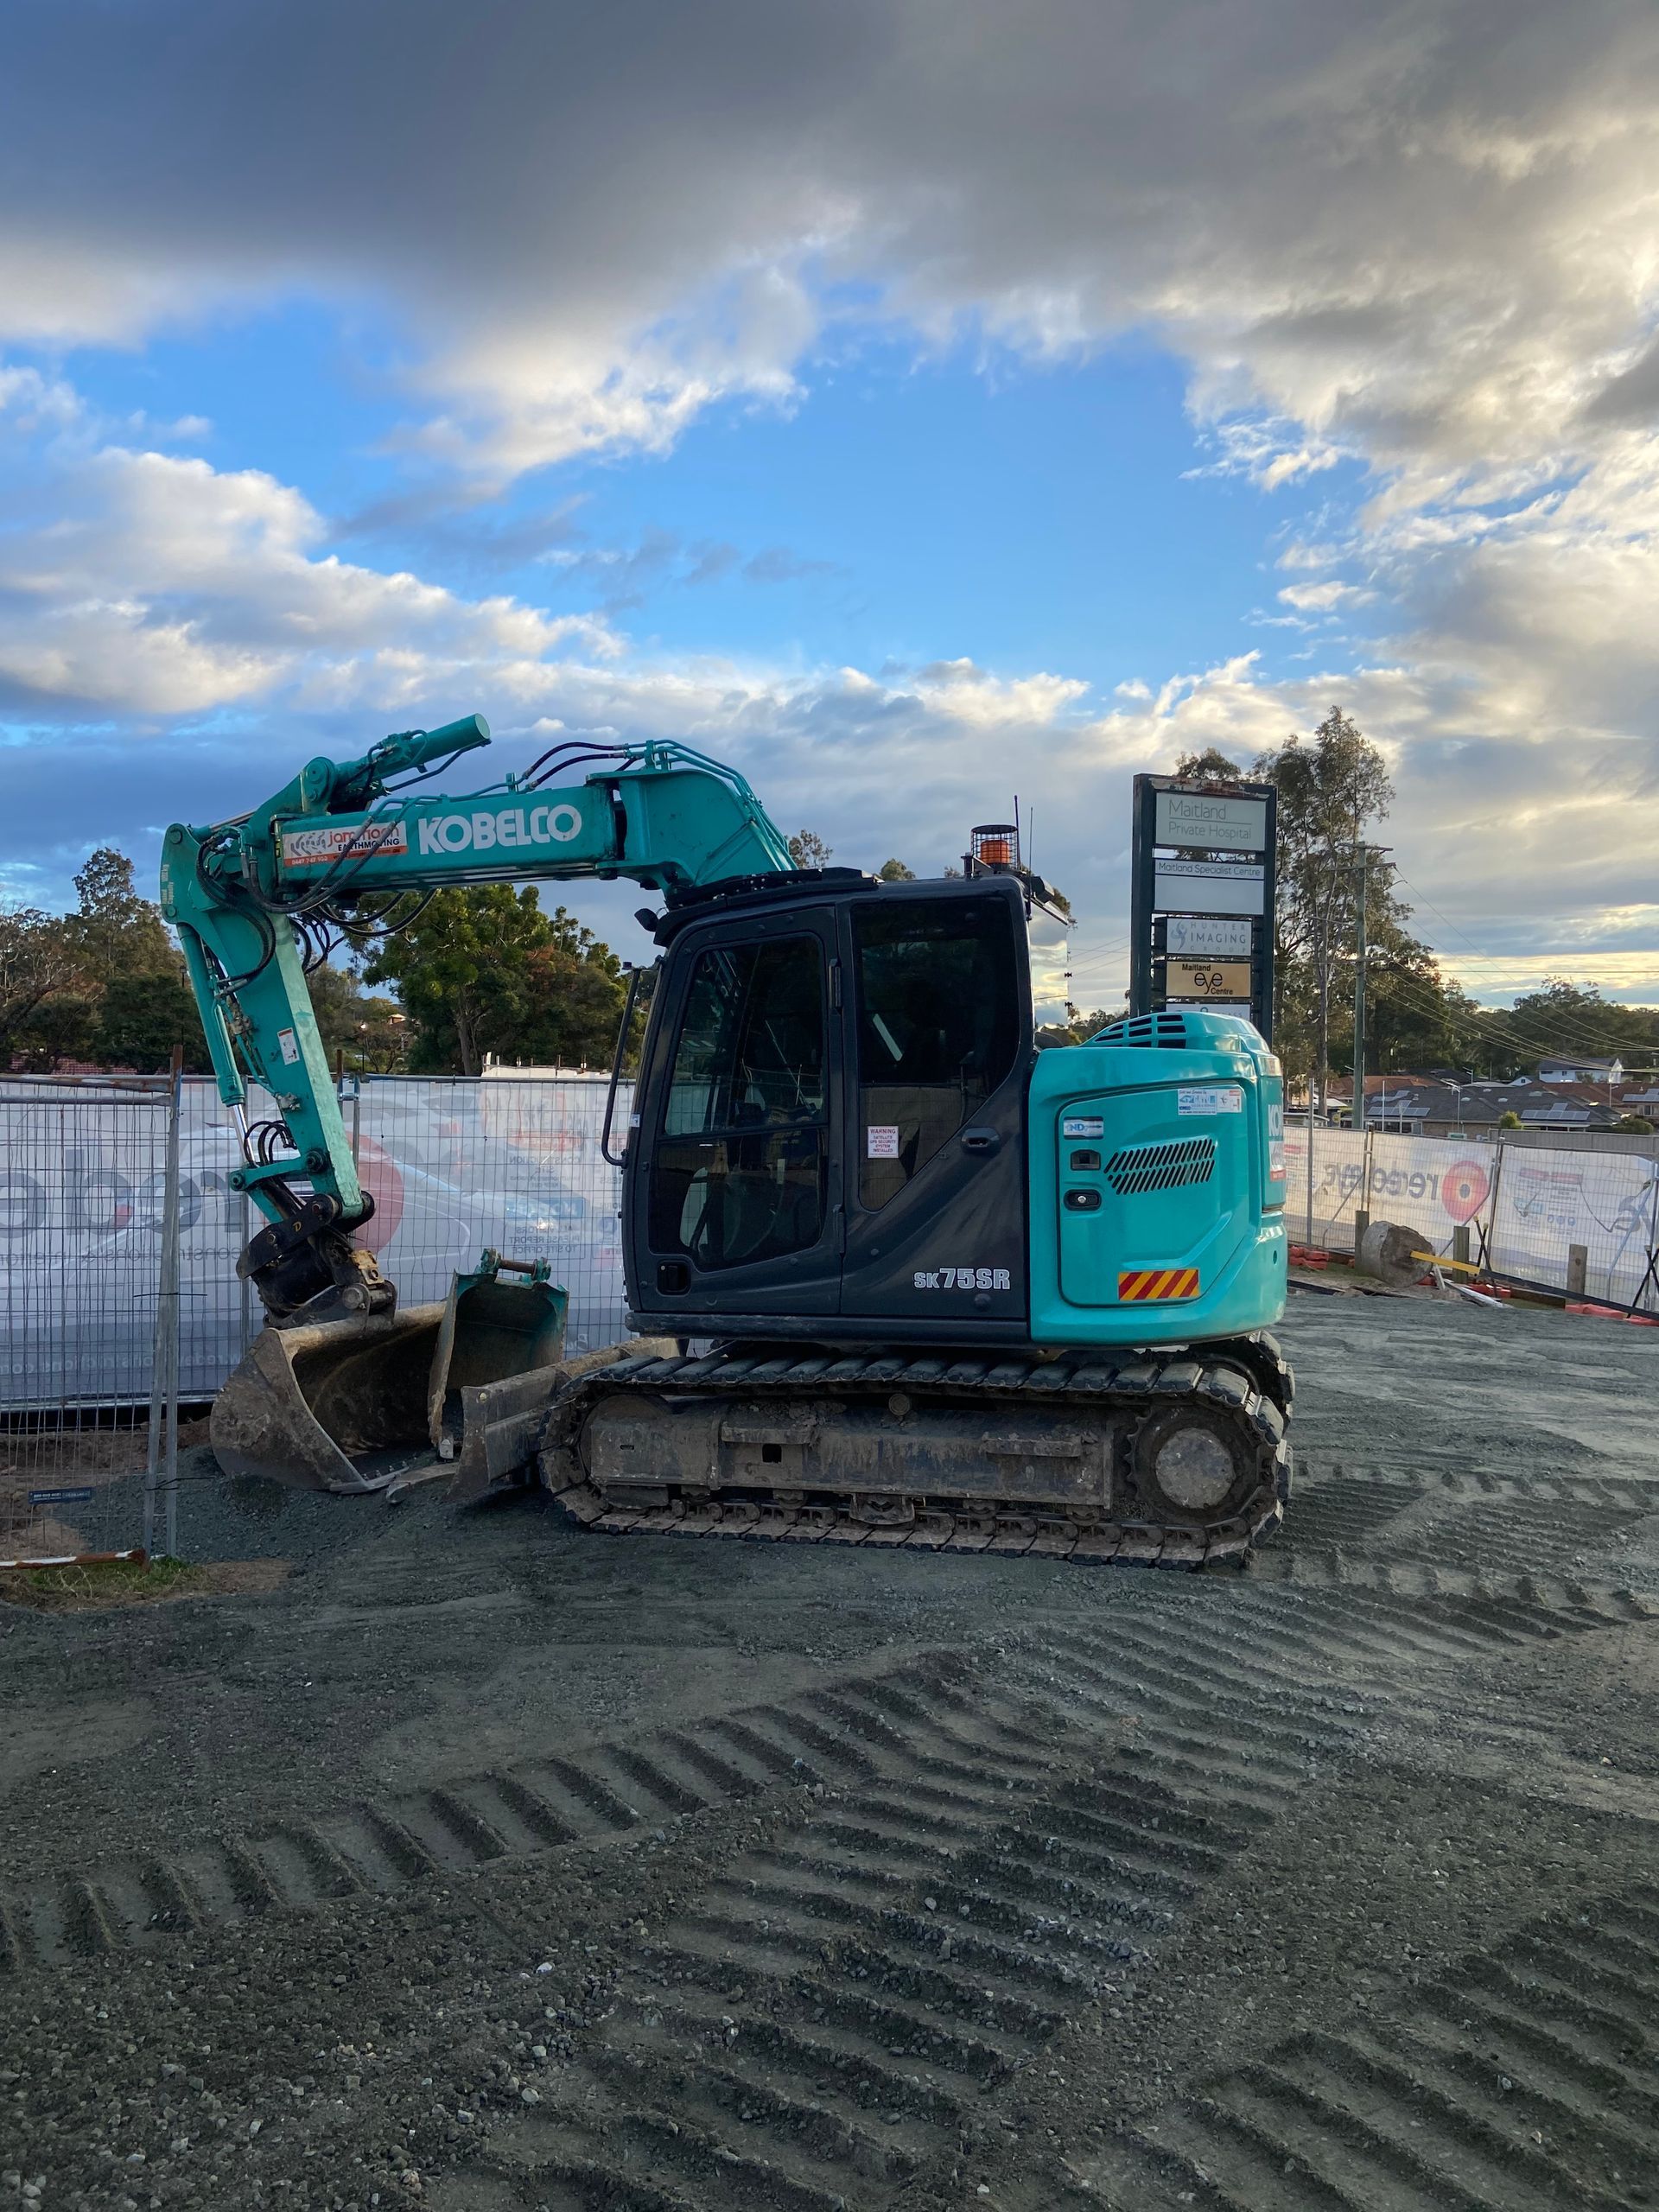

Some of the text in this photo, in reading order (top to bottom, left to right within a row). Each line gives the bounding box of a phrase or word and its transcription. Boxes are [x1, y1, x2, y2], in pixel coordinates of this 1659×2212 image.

[1169, 799, 1226, 820] Maitland
[419, 804, 582, 855] KOBELCO
[1169, 822, 1251, 841] Private Hospital
[1159, 863, 1261, 876] Maitland Specialist Centre
[1191, 922, 1245, 931] HUNTER
[1191, 933, 1246, 944] IMAGING
[1194, 973, 1223, 995] eye
[913, 1268, 1011, 1290] SK75SR
